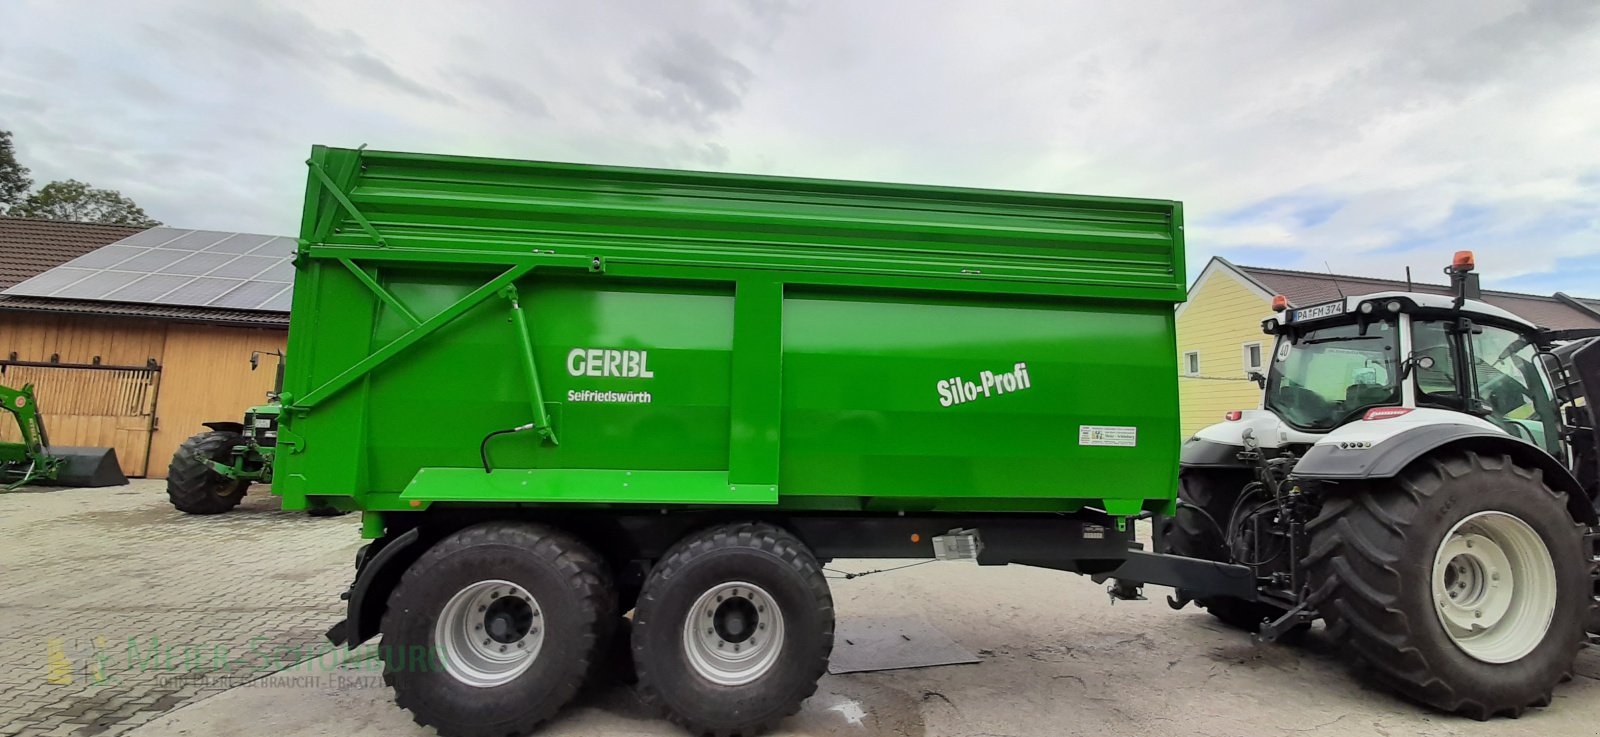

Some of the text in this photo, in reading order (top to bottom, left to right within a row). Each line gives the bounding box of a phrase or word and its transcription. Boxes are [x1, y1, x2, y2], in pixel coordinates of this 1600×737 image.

[1298, 304, 1341, 320] PA FM 374
[1280, 344, 1289, 356] 40
[567, 348, 654, 378] GERBL
[936, 362, 1031, 408] Silo-Profi
[567, 390, 652, 404] Seifriedswörth
